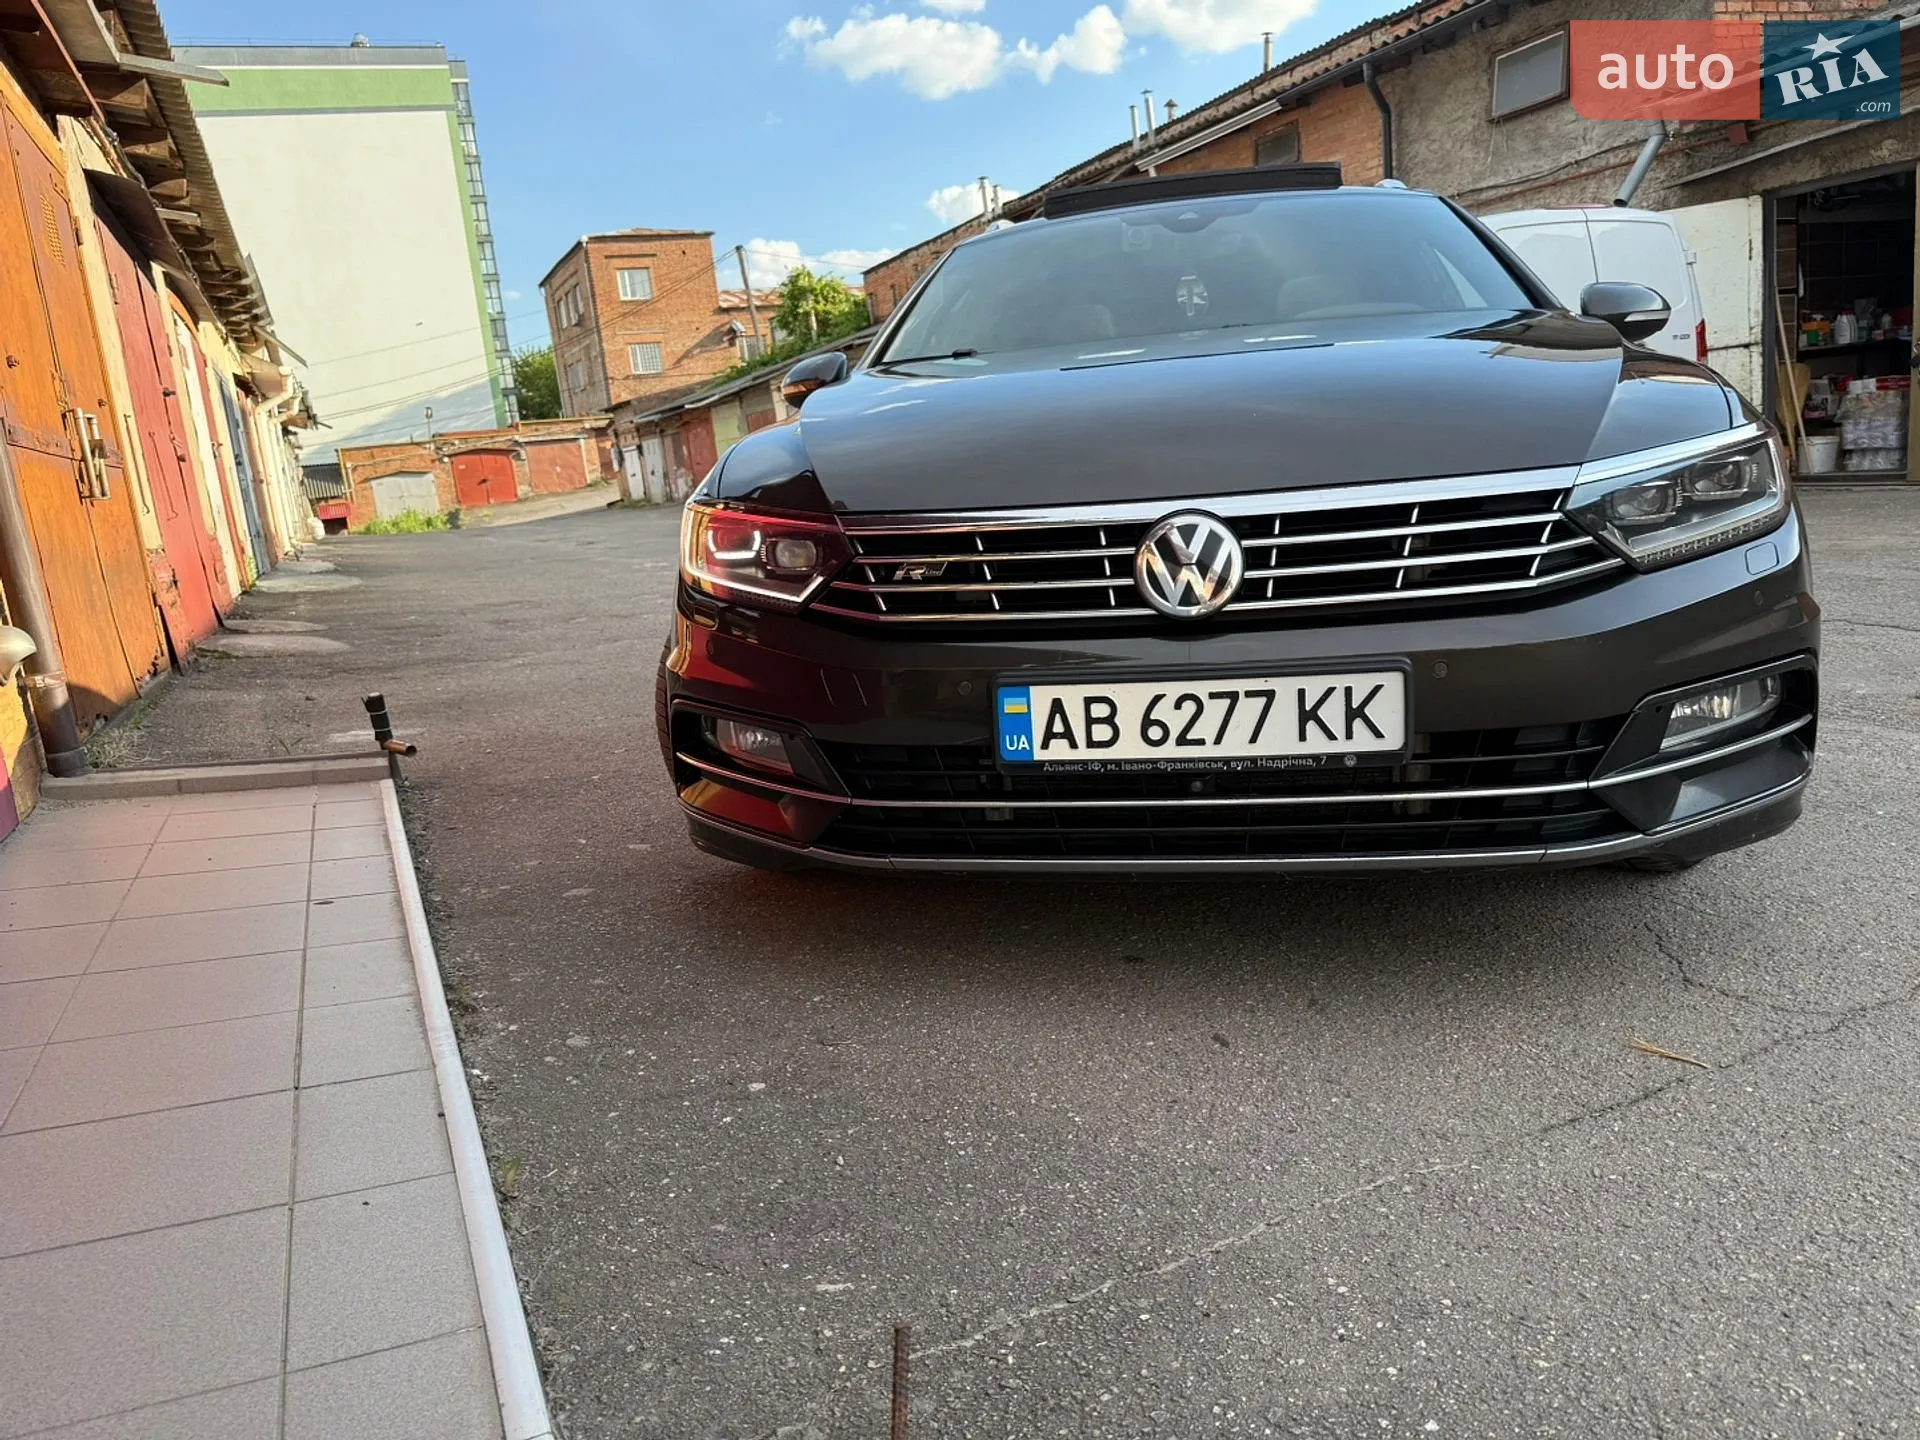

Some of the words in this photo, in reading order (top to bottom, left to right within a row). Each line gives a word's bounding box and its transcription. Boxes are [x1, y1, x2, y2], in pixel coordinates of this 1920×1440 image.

[1040, 696, 1120, 750] AB
[1140, 689, 1276, 747] 6277
[1297, 684, 1386, 741] KK
[1005, 735, 1030, 750] UA
[1257, 755, 1317, 769] Надрічна,
[1319, 756, 1327, 765] 7
